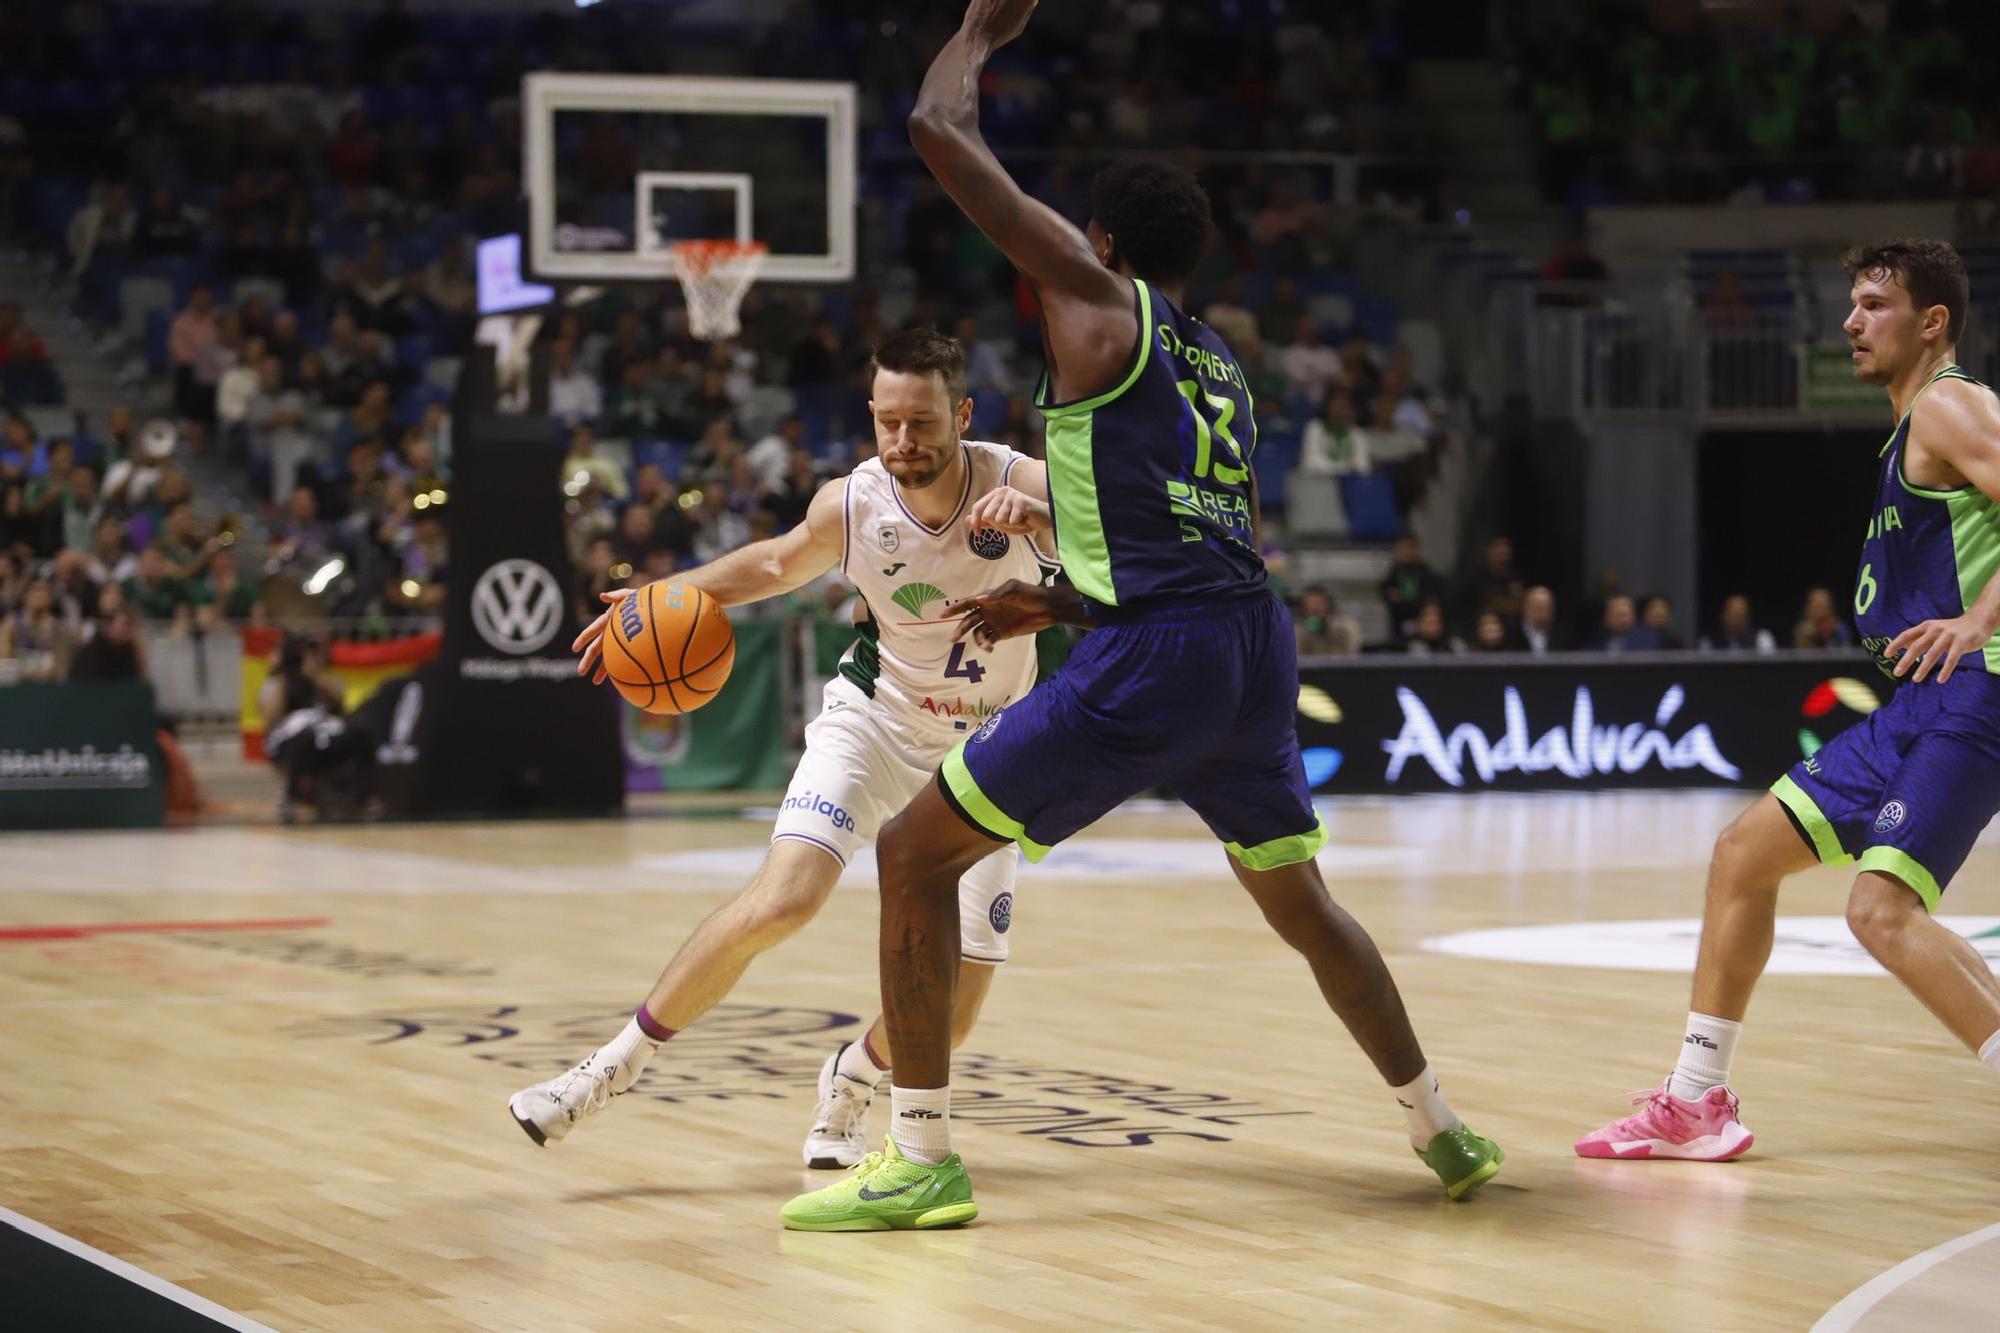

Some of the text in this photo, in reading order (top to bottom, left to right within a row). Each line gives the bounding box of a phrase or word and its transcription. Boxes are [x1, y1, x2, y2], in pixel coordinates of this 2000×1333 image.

[1175, 379, 1249, 485] 13
[1854, 563, 1877, 616] 6
[943, 641, 986, 684] 4
[1380, 683, 1743, 787] Andalucía
